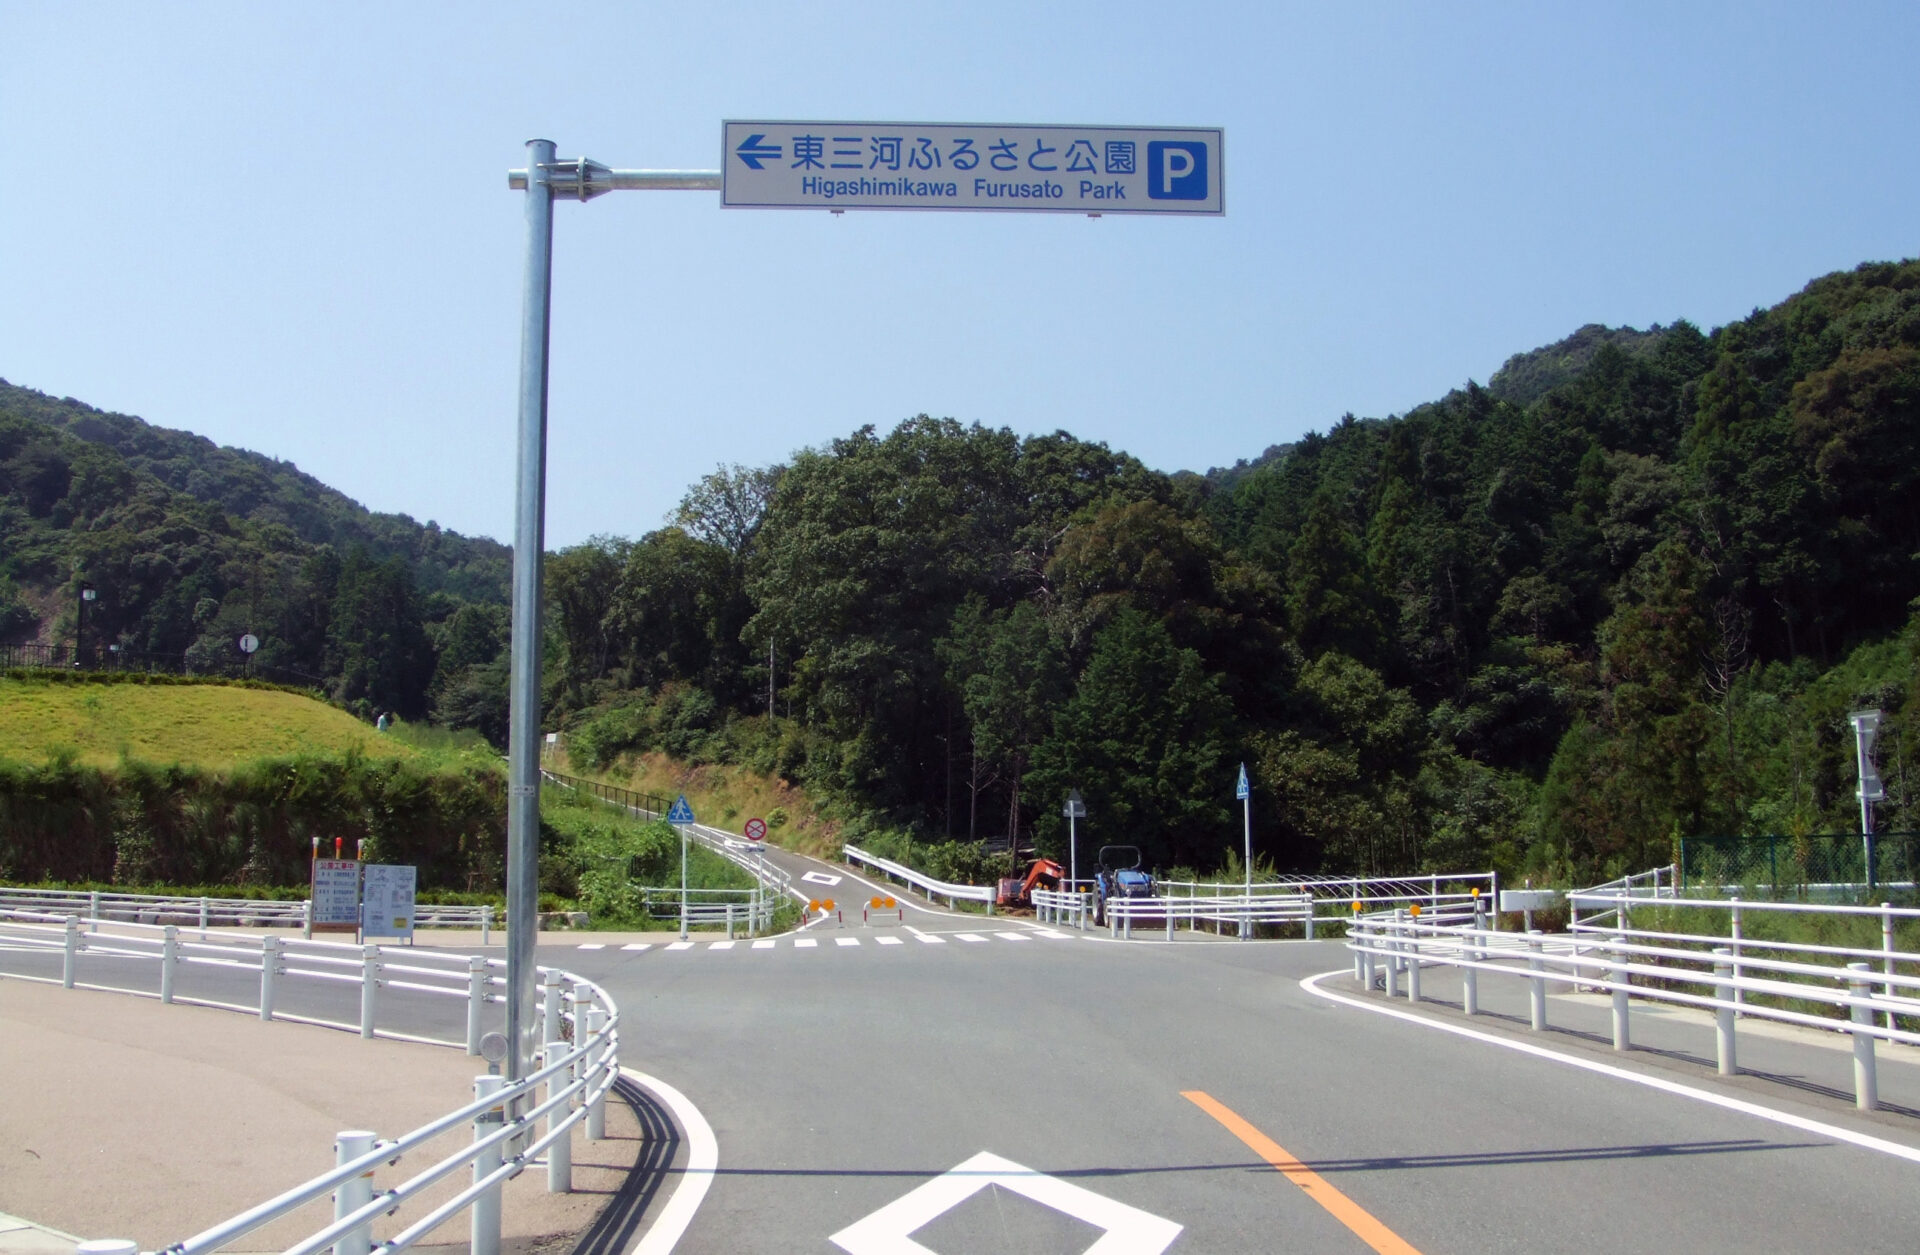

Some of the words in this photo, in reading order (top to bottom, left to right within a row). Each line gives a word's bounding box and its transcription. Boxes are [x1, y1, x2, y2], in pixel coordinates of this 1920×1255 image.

[791, 134, 1136, 174] 東三河ふるさと公園
[1163, 147, 1195, 193] P
[802, 176, 957, 198] Higashimikawa
[974, 178, 1063, 198] Furusato
[1079, 180, 1126, 199] Park
